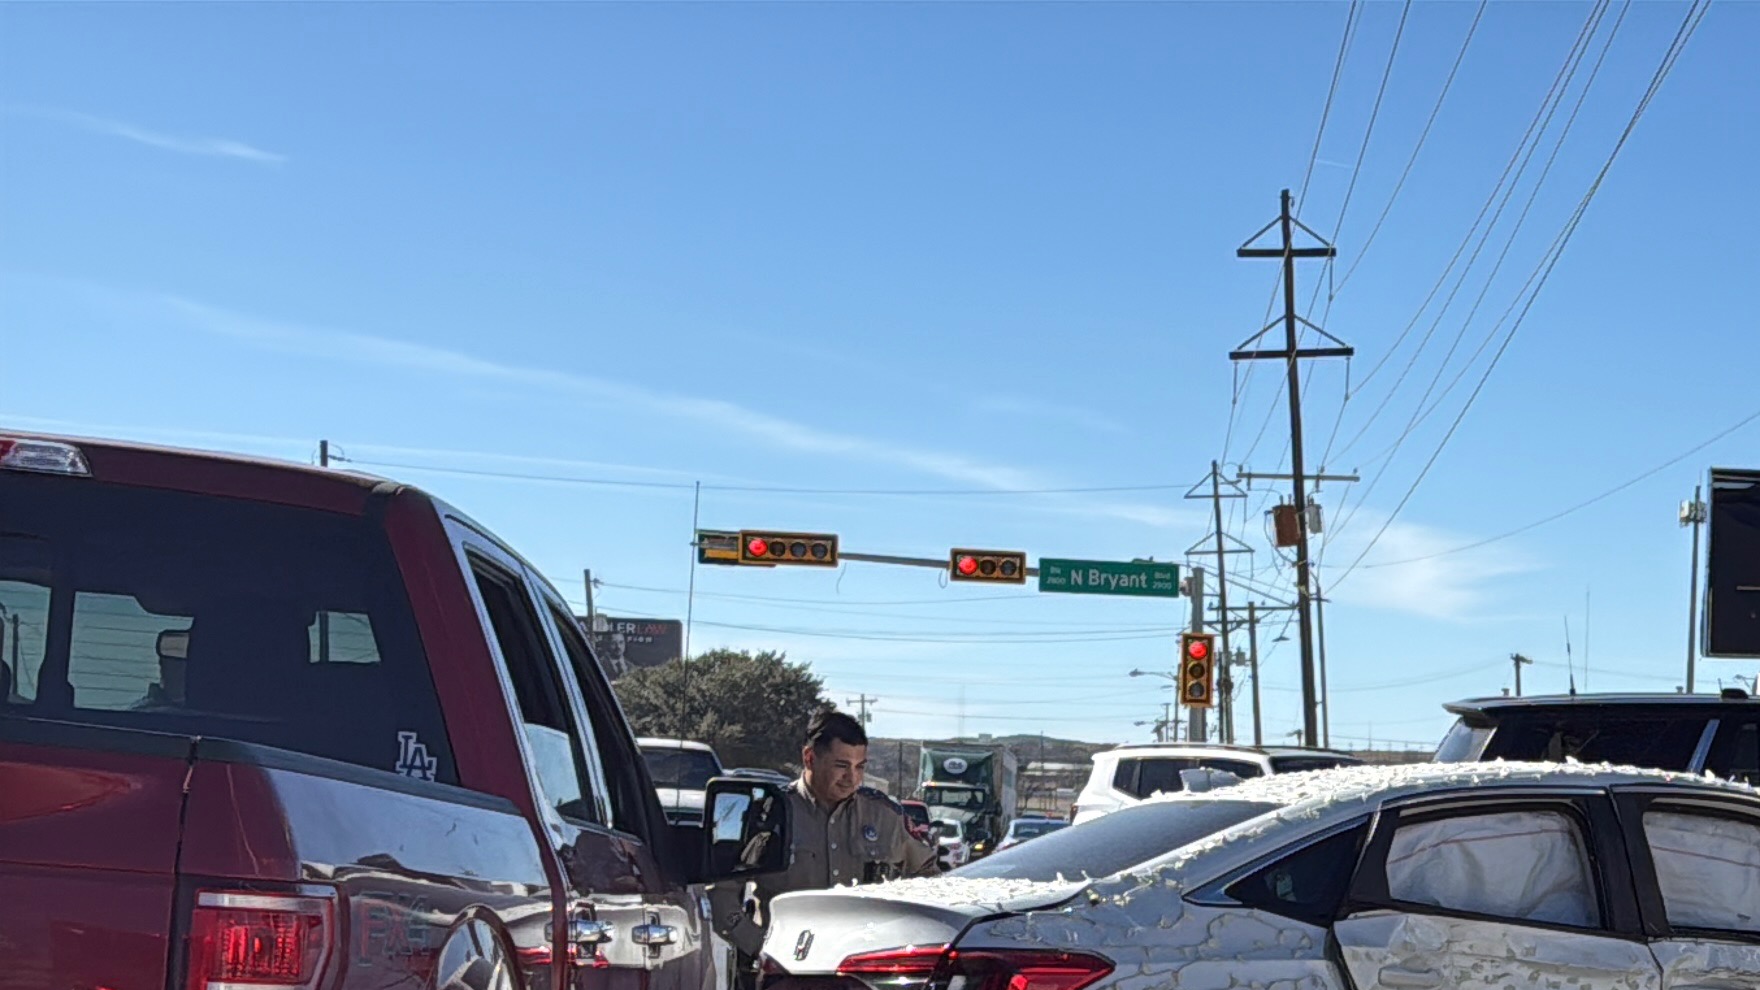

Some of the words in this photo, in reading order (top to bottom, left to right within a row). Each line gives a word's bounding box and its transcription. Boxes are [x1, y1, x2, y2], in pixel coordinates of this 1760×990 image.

[1070, 569, 1082, 586] N
[1088, 569, 1148, 590] Bryant
[395, 731, 437, 782] LA
